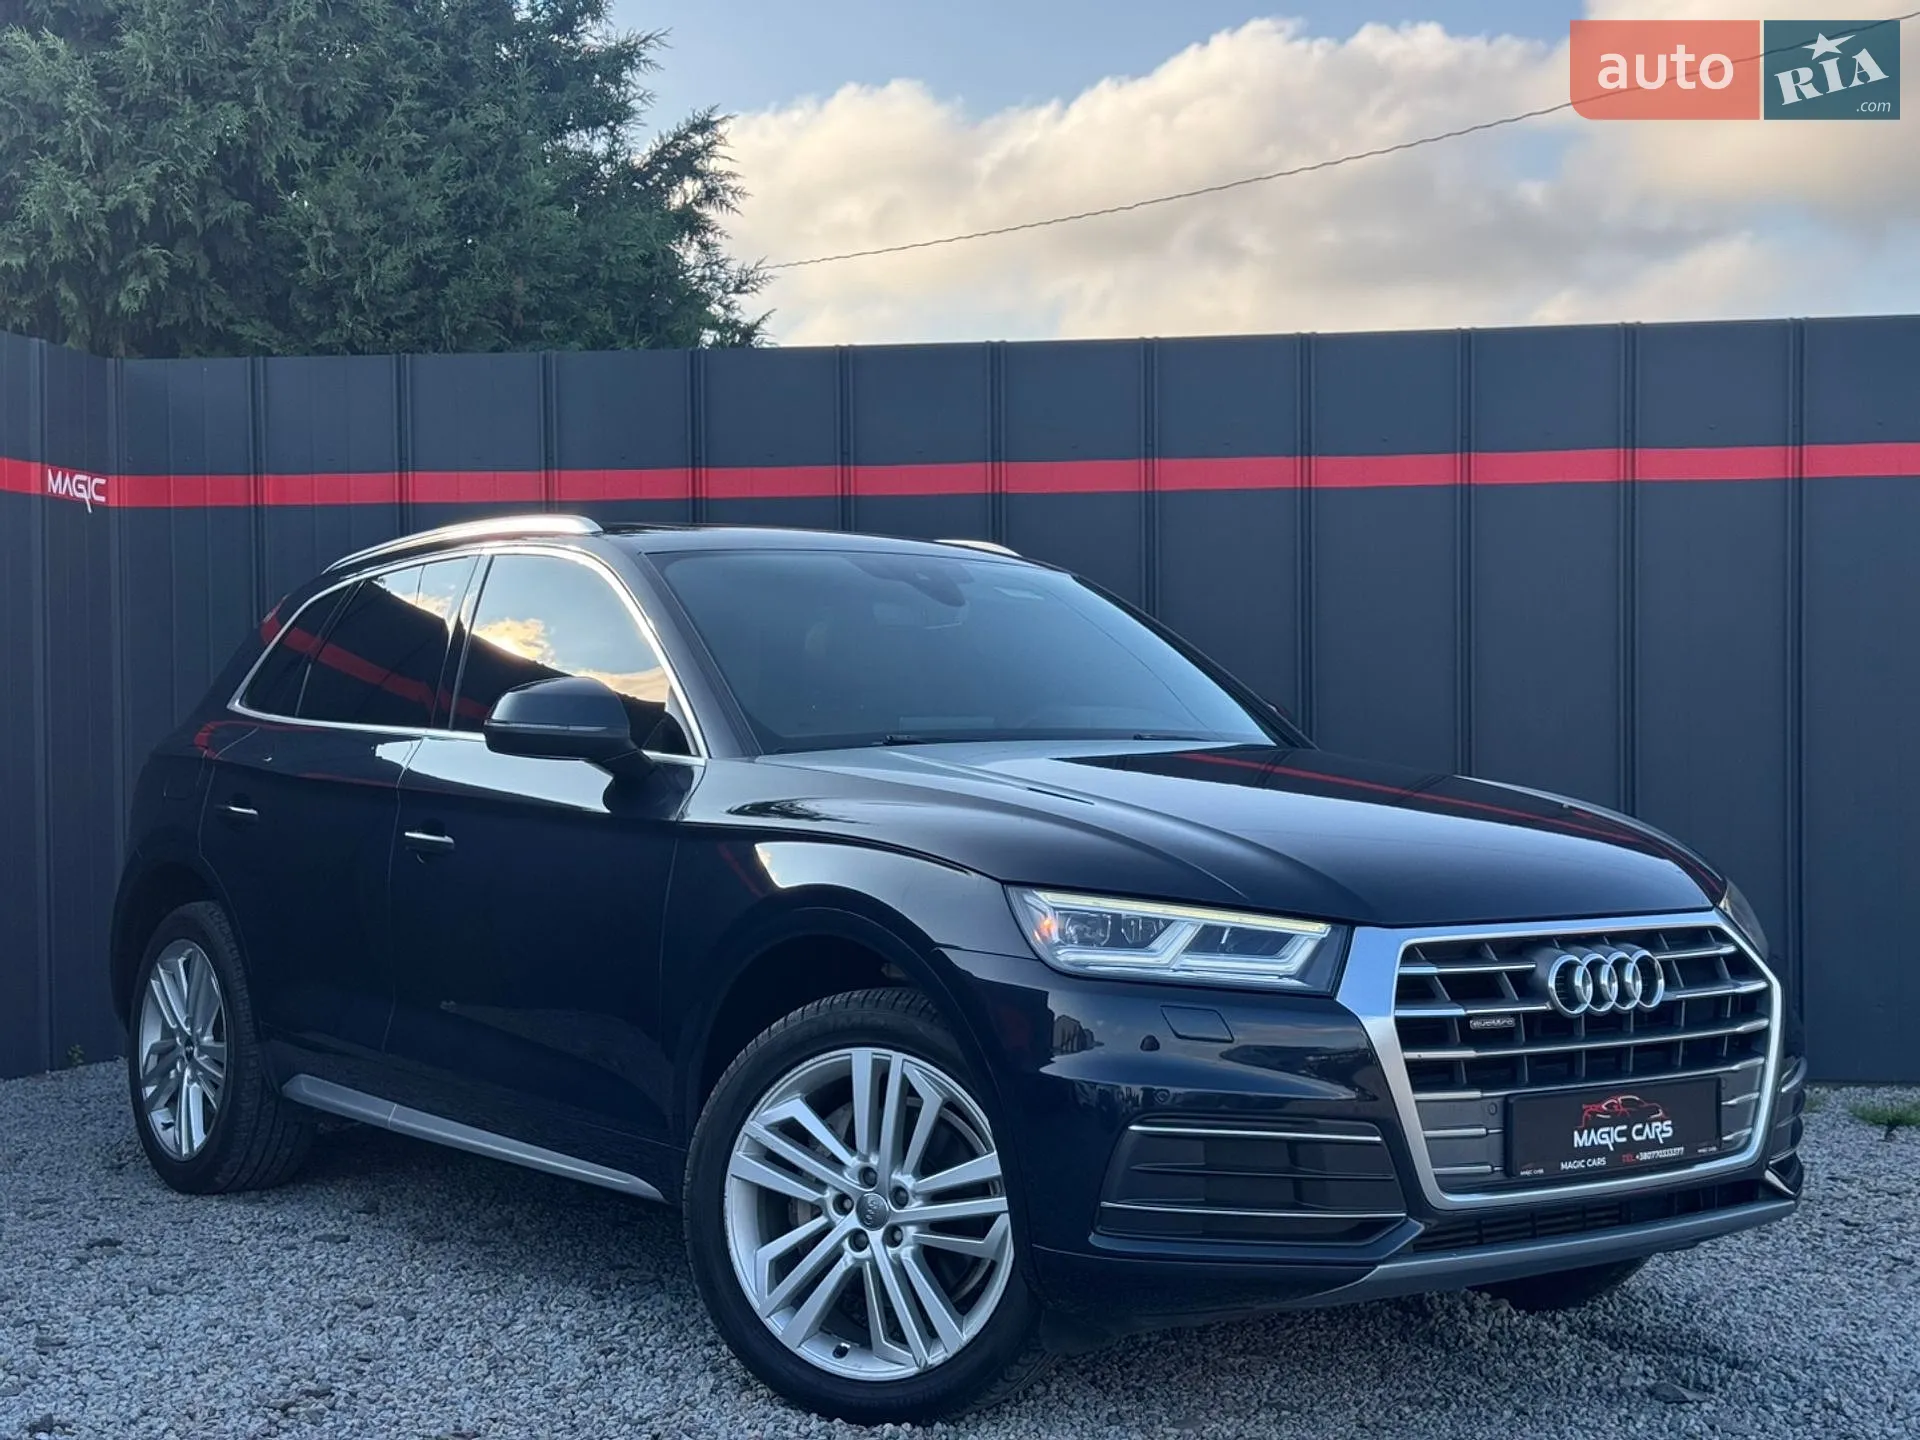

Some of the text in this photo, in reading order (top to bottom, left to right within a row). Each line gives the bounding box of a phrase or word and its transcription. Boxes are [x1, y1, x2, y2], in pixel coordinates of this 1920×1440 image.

[47, 468, 107, 513] MAGIC
[1573, 1120, 1673, 1151] MAGIC CARS
[1560, 1157, 1607, 1171] MAGIC CARS
